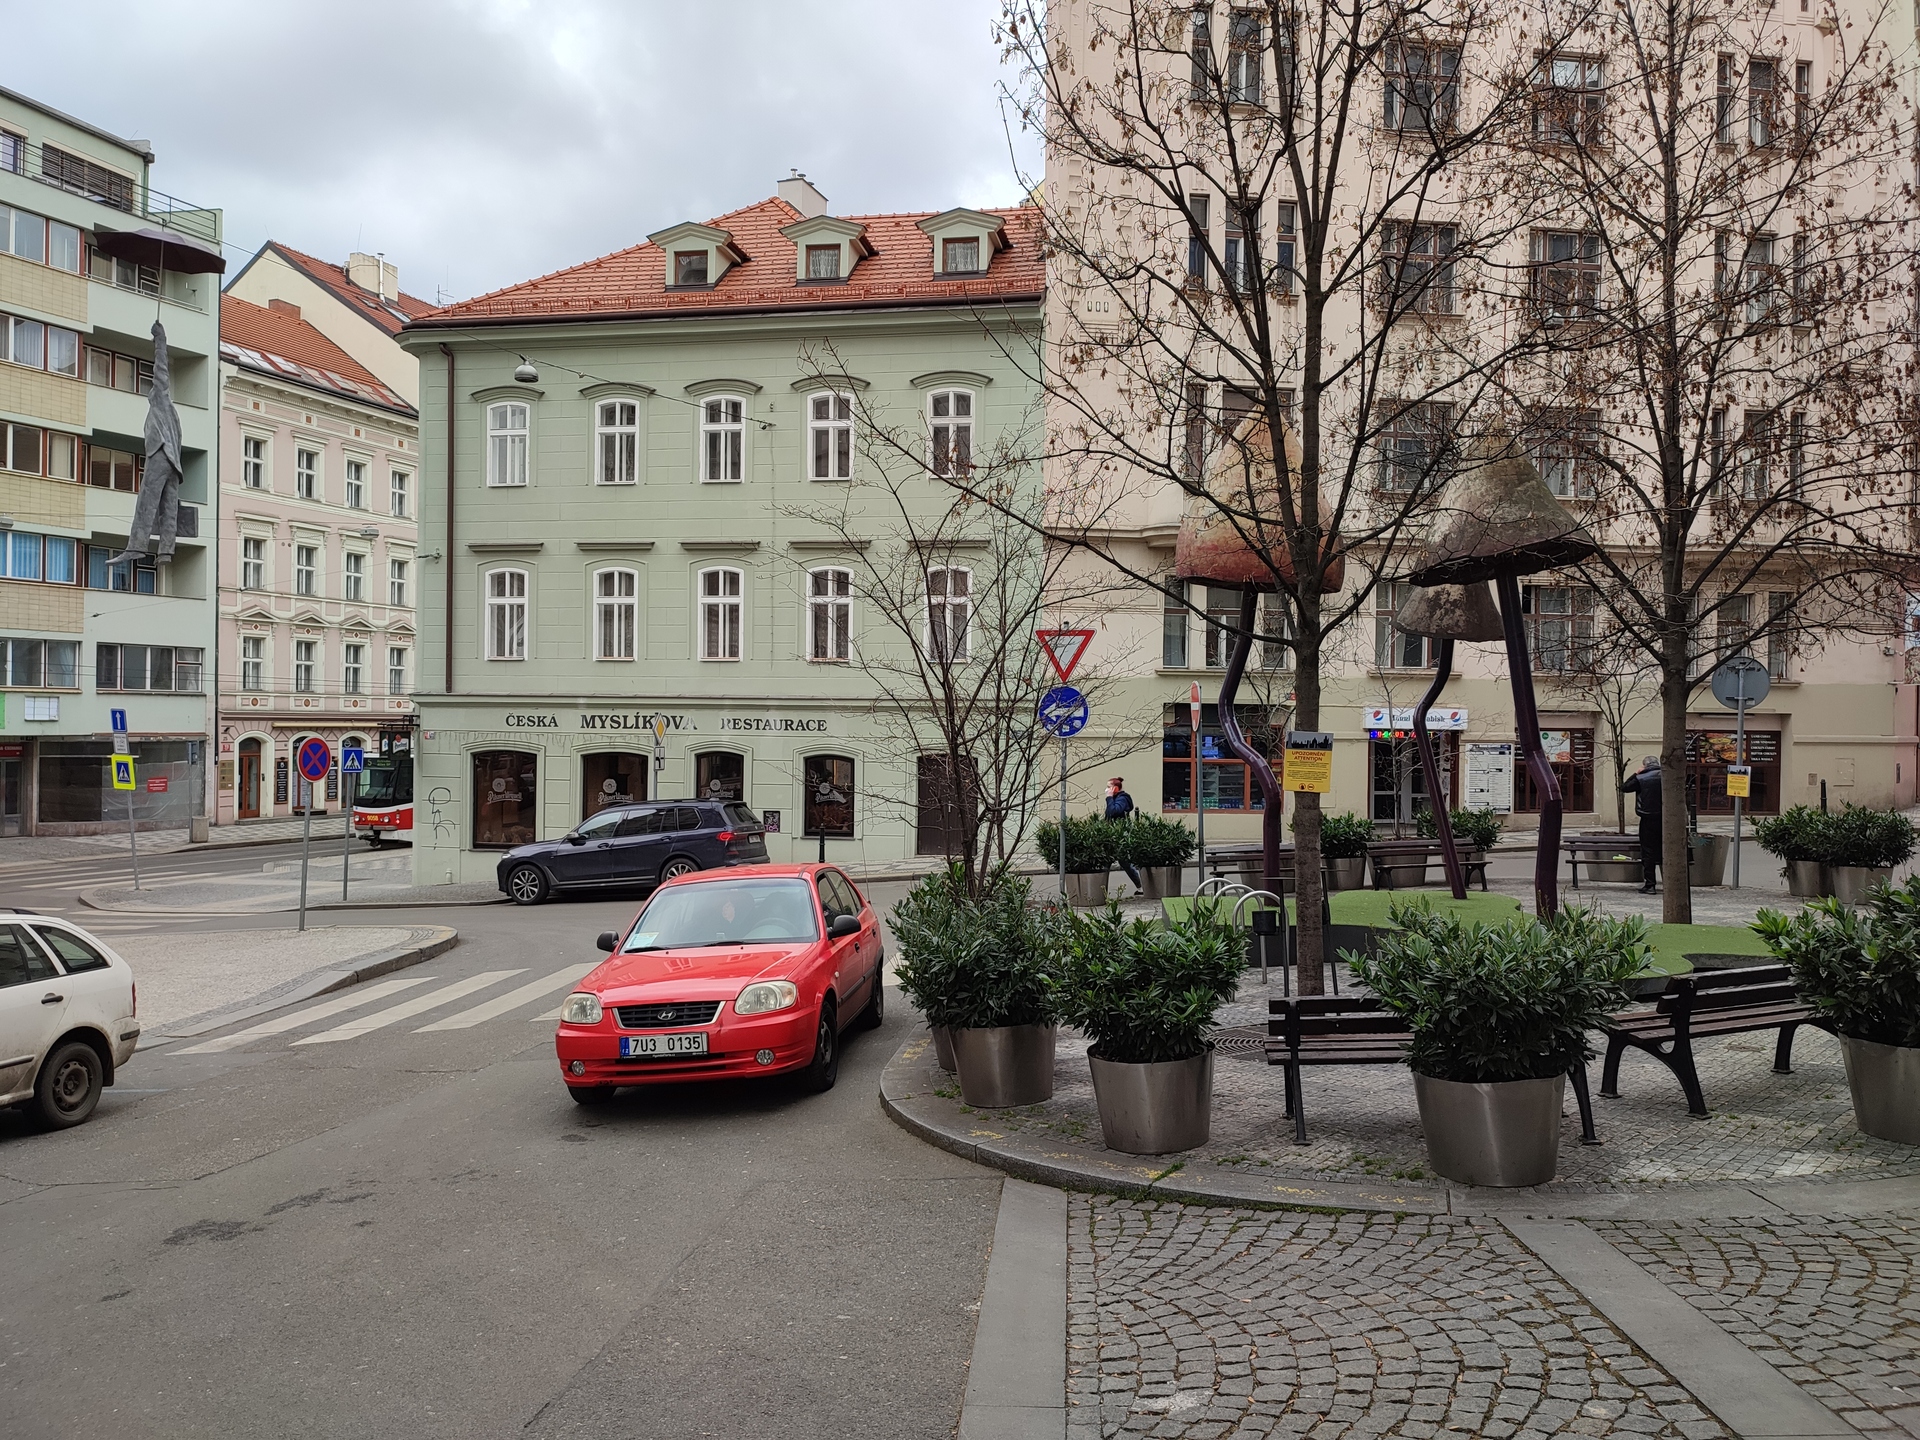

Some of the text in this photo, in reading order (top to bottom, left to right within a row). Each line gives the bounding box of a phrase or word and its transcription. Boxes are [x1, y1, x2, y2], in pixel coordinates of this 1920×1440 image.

[505, 712, 559, 728] ČESKÁ
[720, 717, 828, 732] RESTAURACE
[632, 1036, 701, 1053] 7U3 0135
